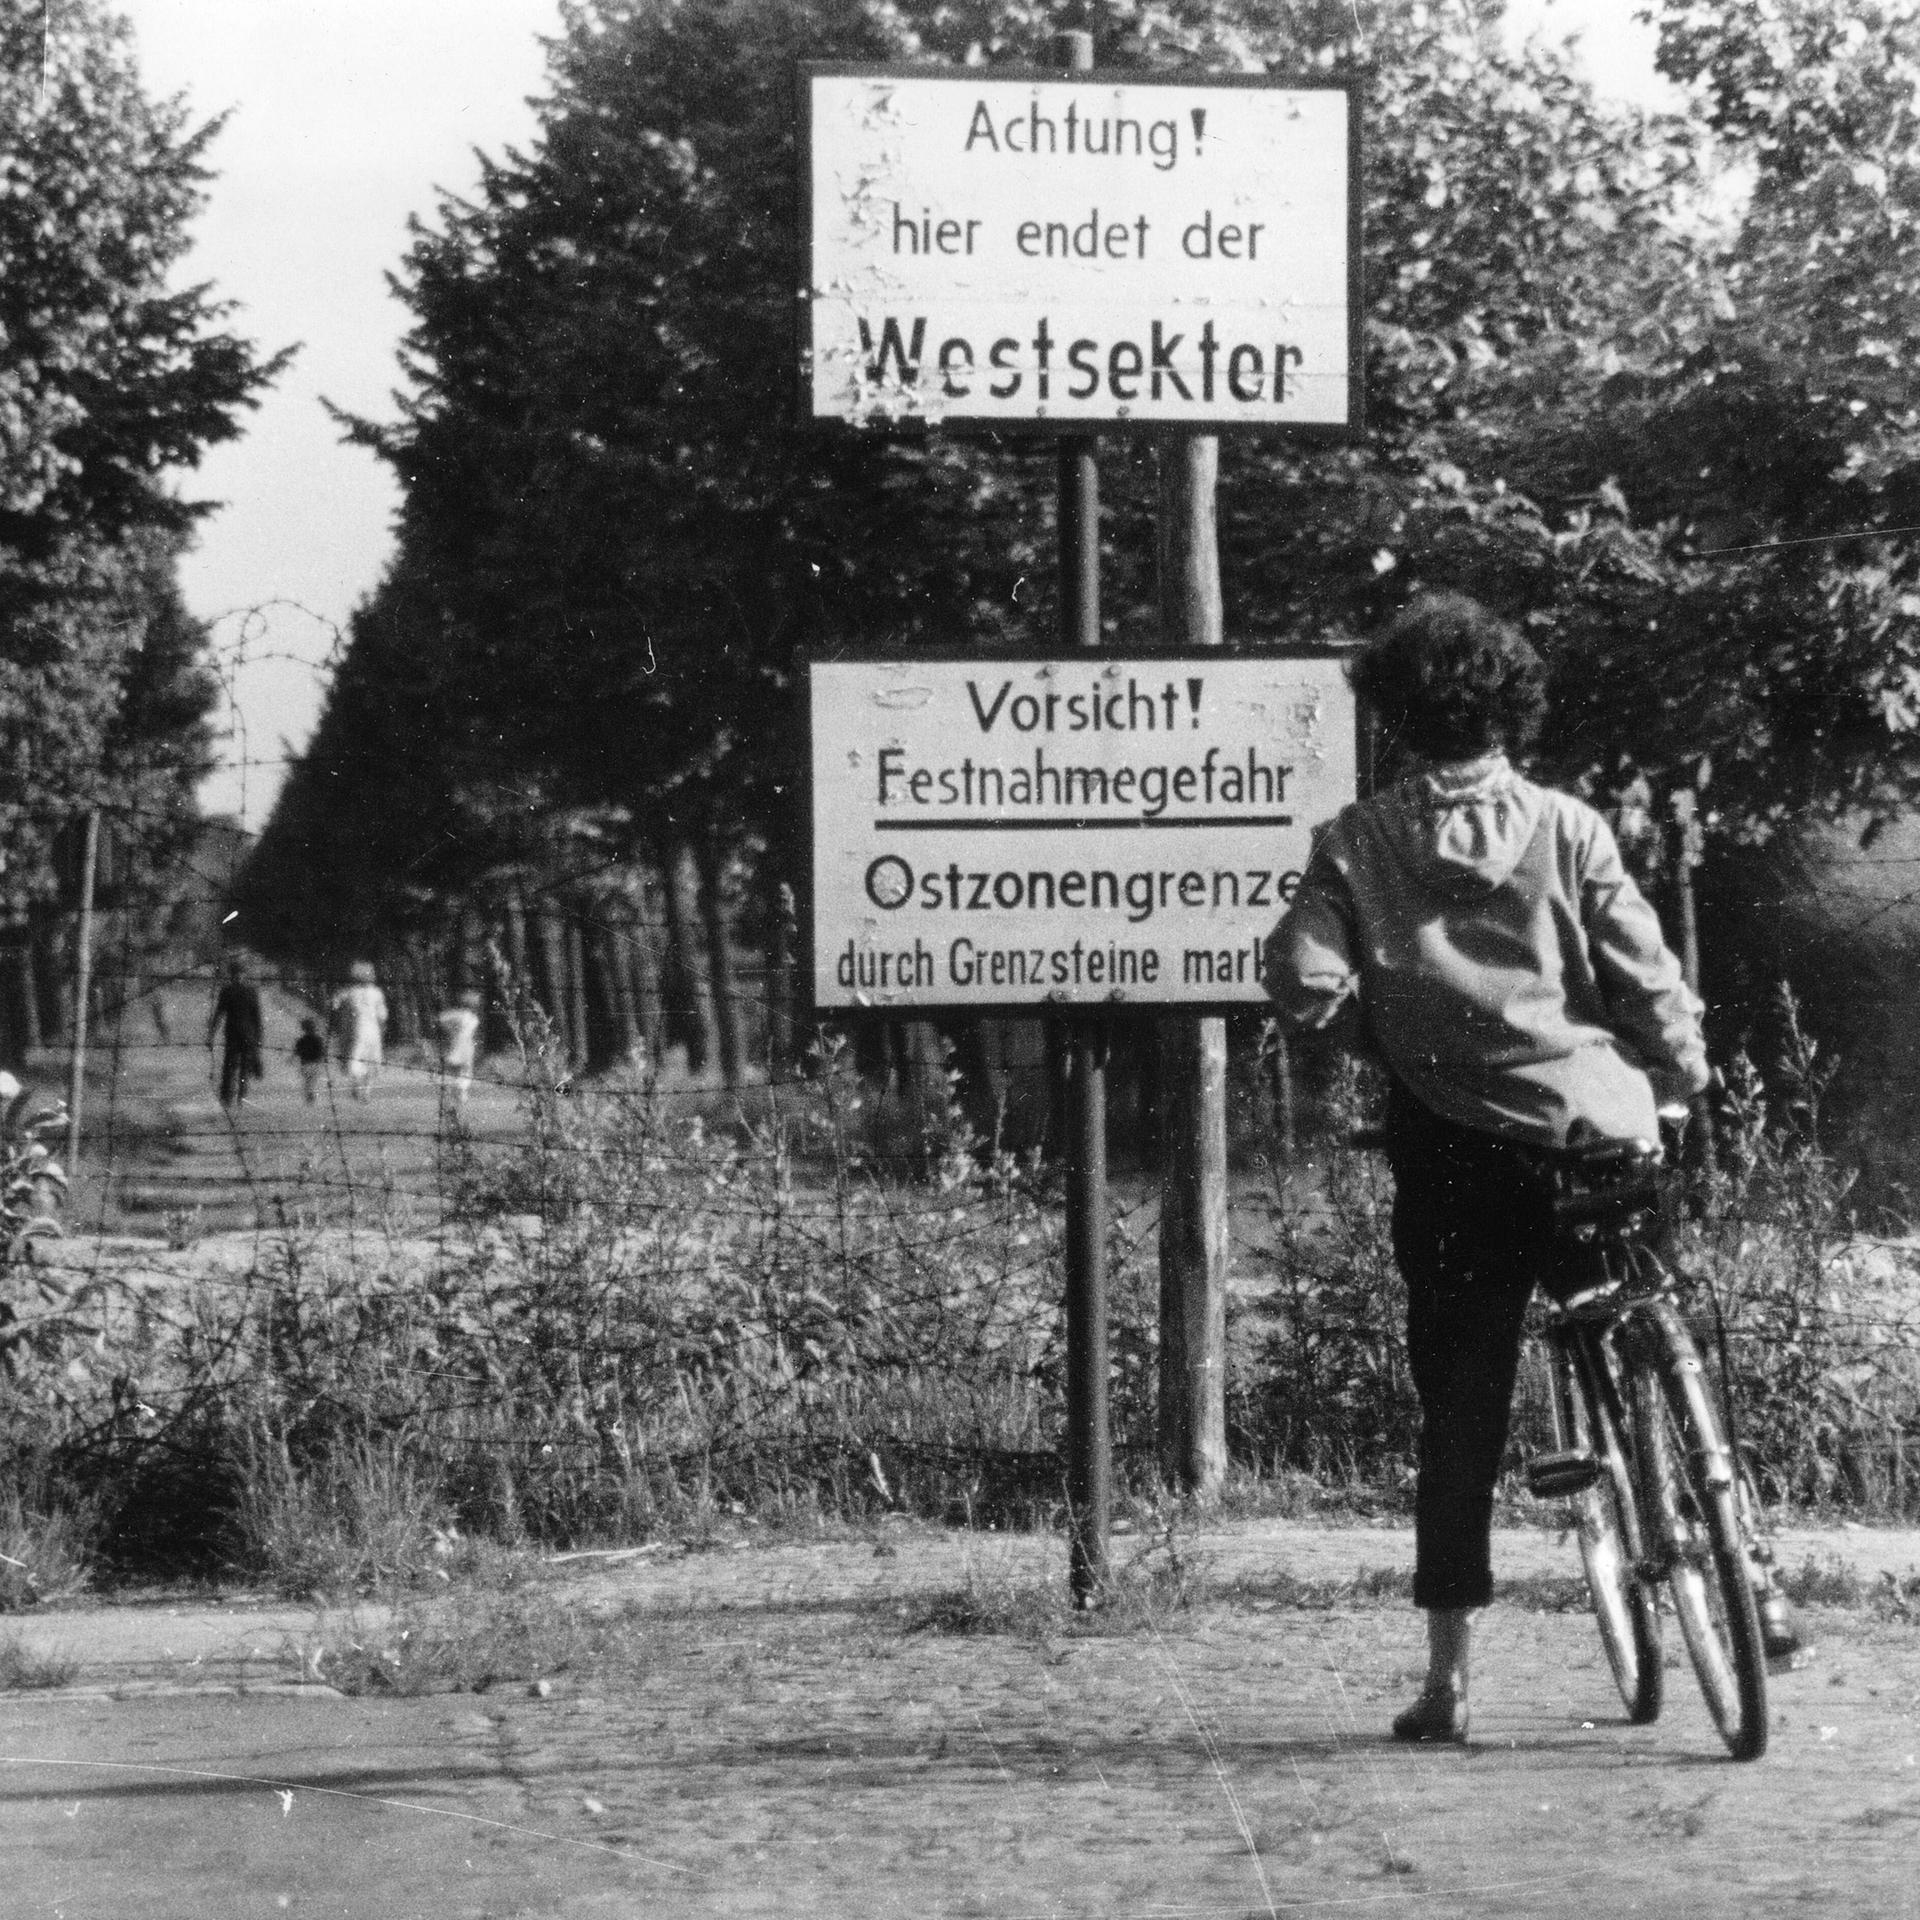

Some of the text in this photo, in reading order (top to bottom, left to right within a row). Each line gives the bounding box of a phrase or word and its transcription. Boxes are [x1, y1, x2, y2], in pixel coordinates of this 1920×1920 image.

[965, 100, 1206, 171] Achtung!
[893, 203, 1265, 260] hier endet der
[966, 679, 1204, 732] Vorsicht!
[878, 747, 1293, 816] Festnahmegefahr
[865, 854, 1300, 923] Ostzonengrenze
[838, 938, 934, 988] durch
[949, 937, 1159, 986] Grenzsteine
